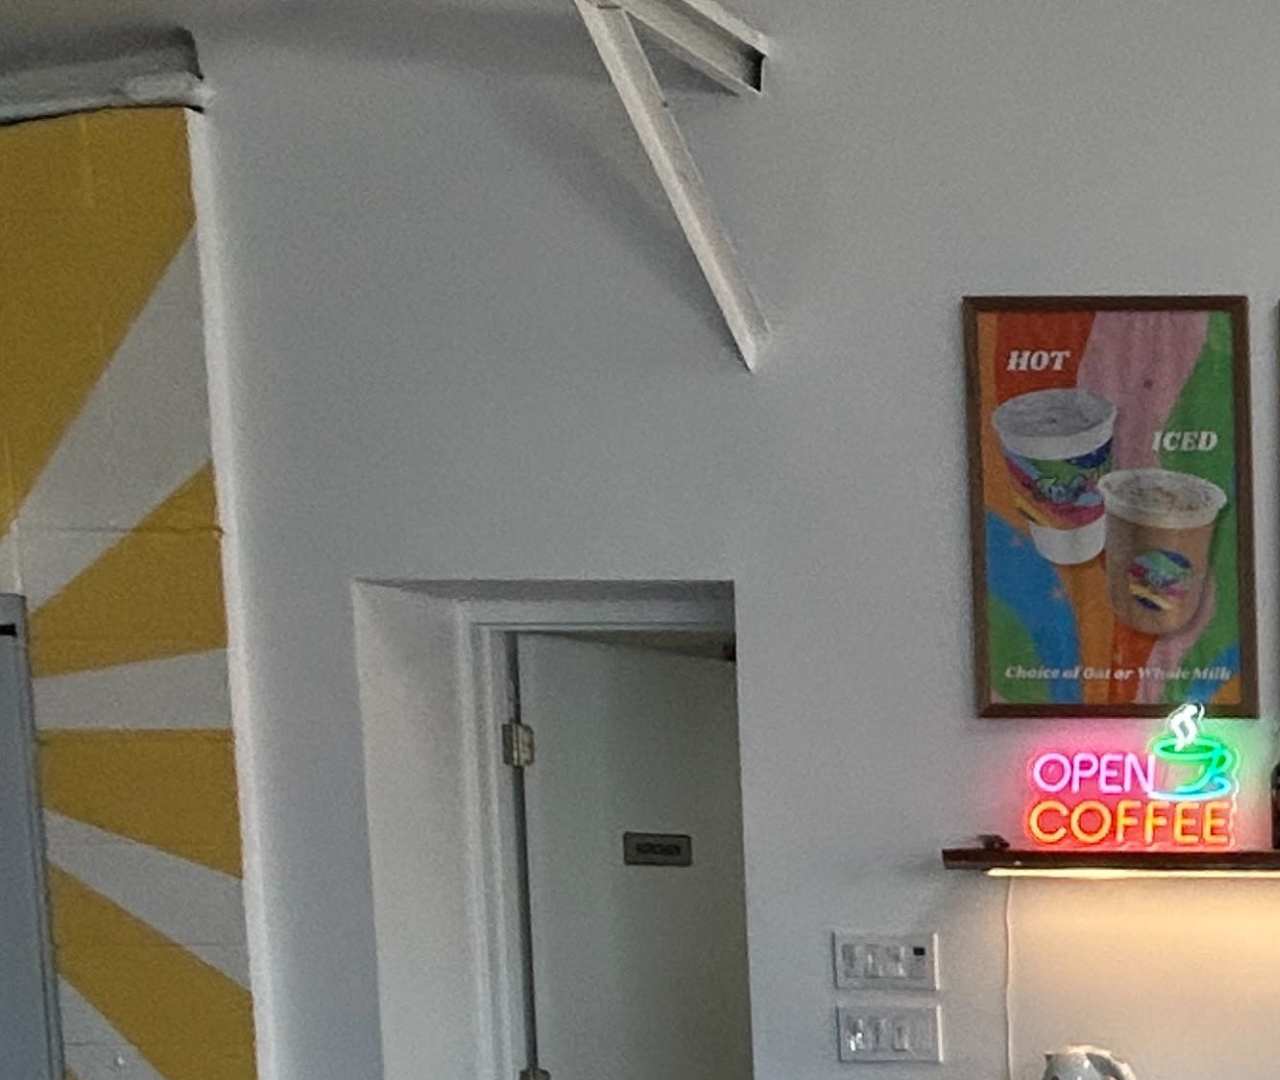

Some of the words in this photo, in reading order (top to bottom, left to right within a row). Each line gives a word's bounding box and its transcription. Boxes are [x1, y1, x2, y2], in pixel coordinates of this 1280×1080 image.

[1007, 350, 1070, 371] HOT
[1152, 431, 1218, 452] ICED
[1005, 666, 1060, 679] Choice
[1063, 665, 1080, 680] of
[1115, 669, 1131, 680] or
[1192, 667, 1233, 680] Milk
[1033, 752, 1156, 793] OPEN
[1029, 800, 1231, 844] COFFEE
